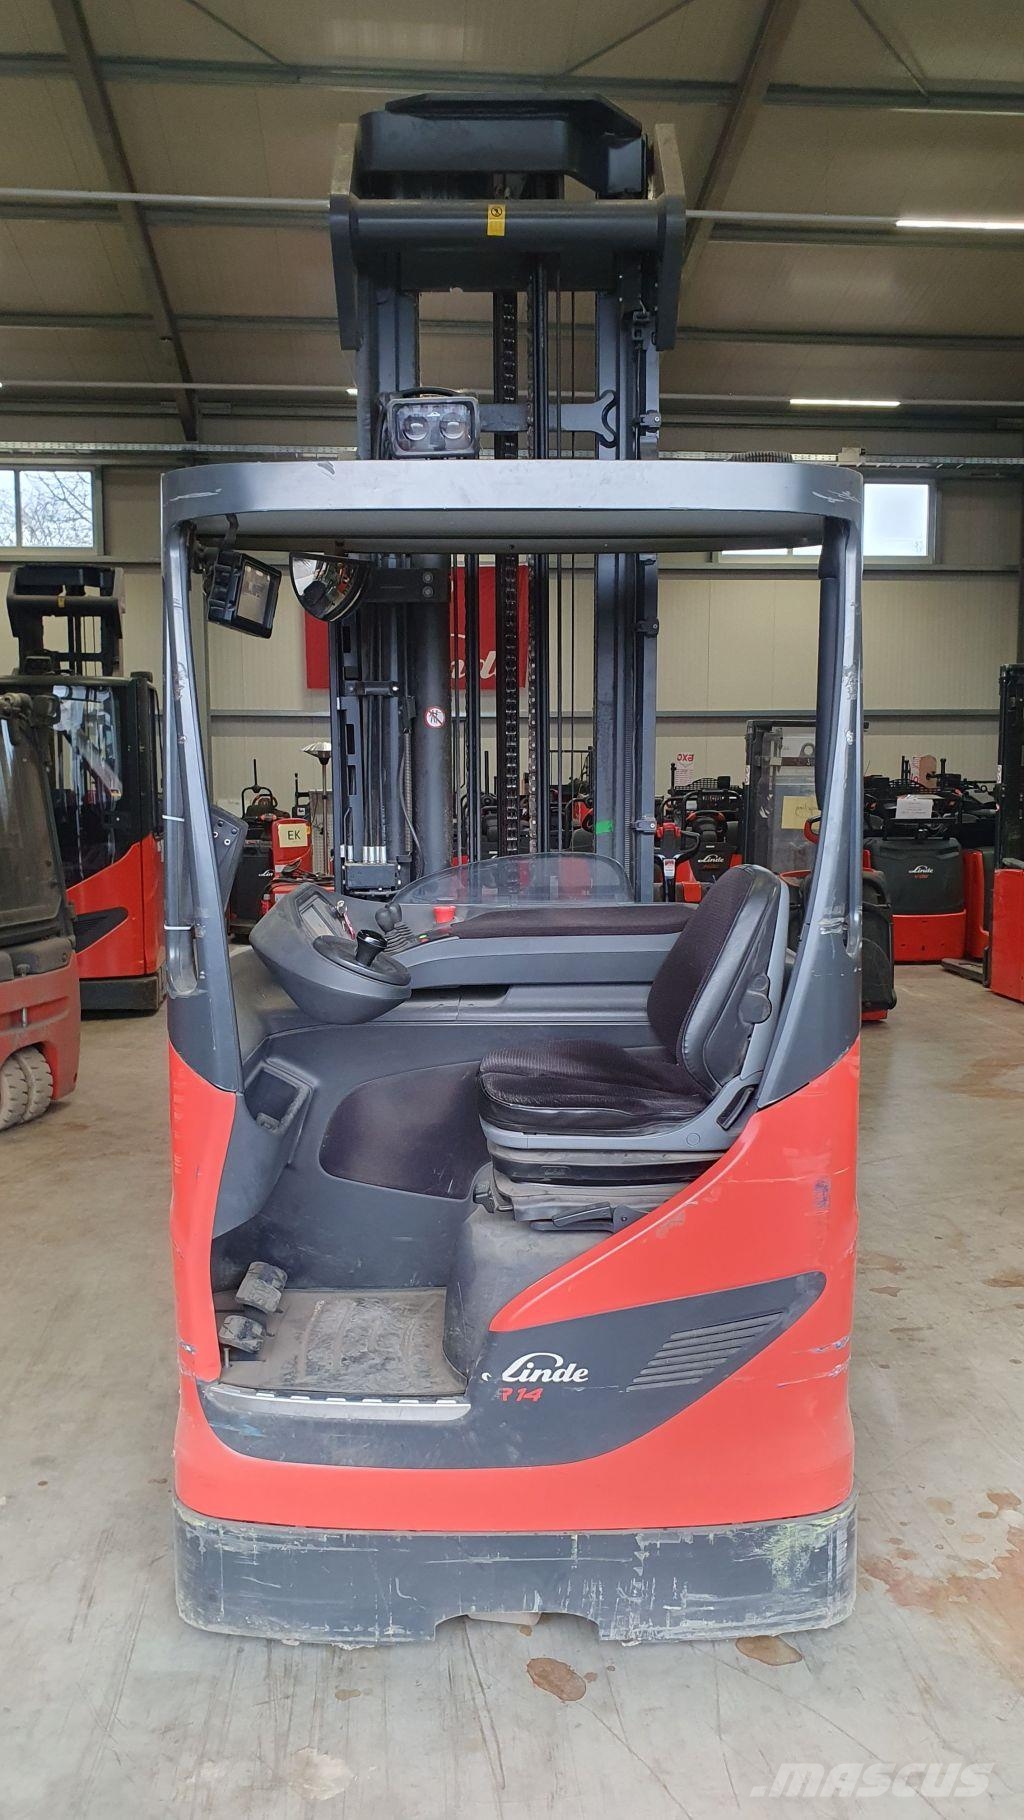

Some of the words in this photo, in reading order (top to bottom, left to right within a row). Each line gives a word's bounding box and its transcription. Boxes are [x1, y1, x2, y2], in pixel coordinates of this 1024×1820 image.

[287, 830, 301, 840] EK
[698, 854, 724, 863] Linde
[482, 1352, 589, 1382] Linde
